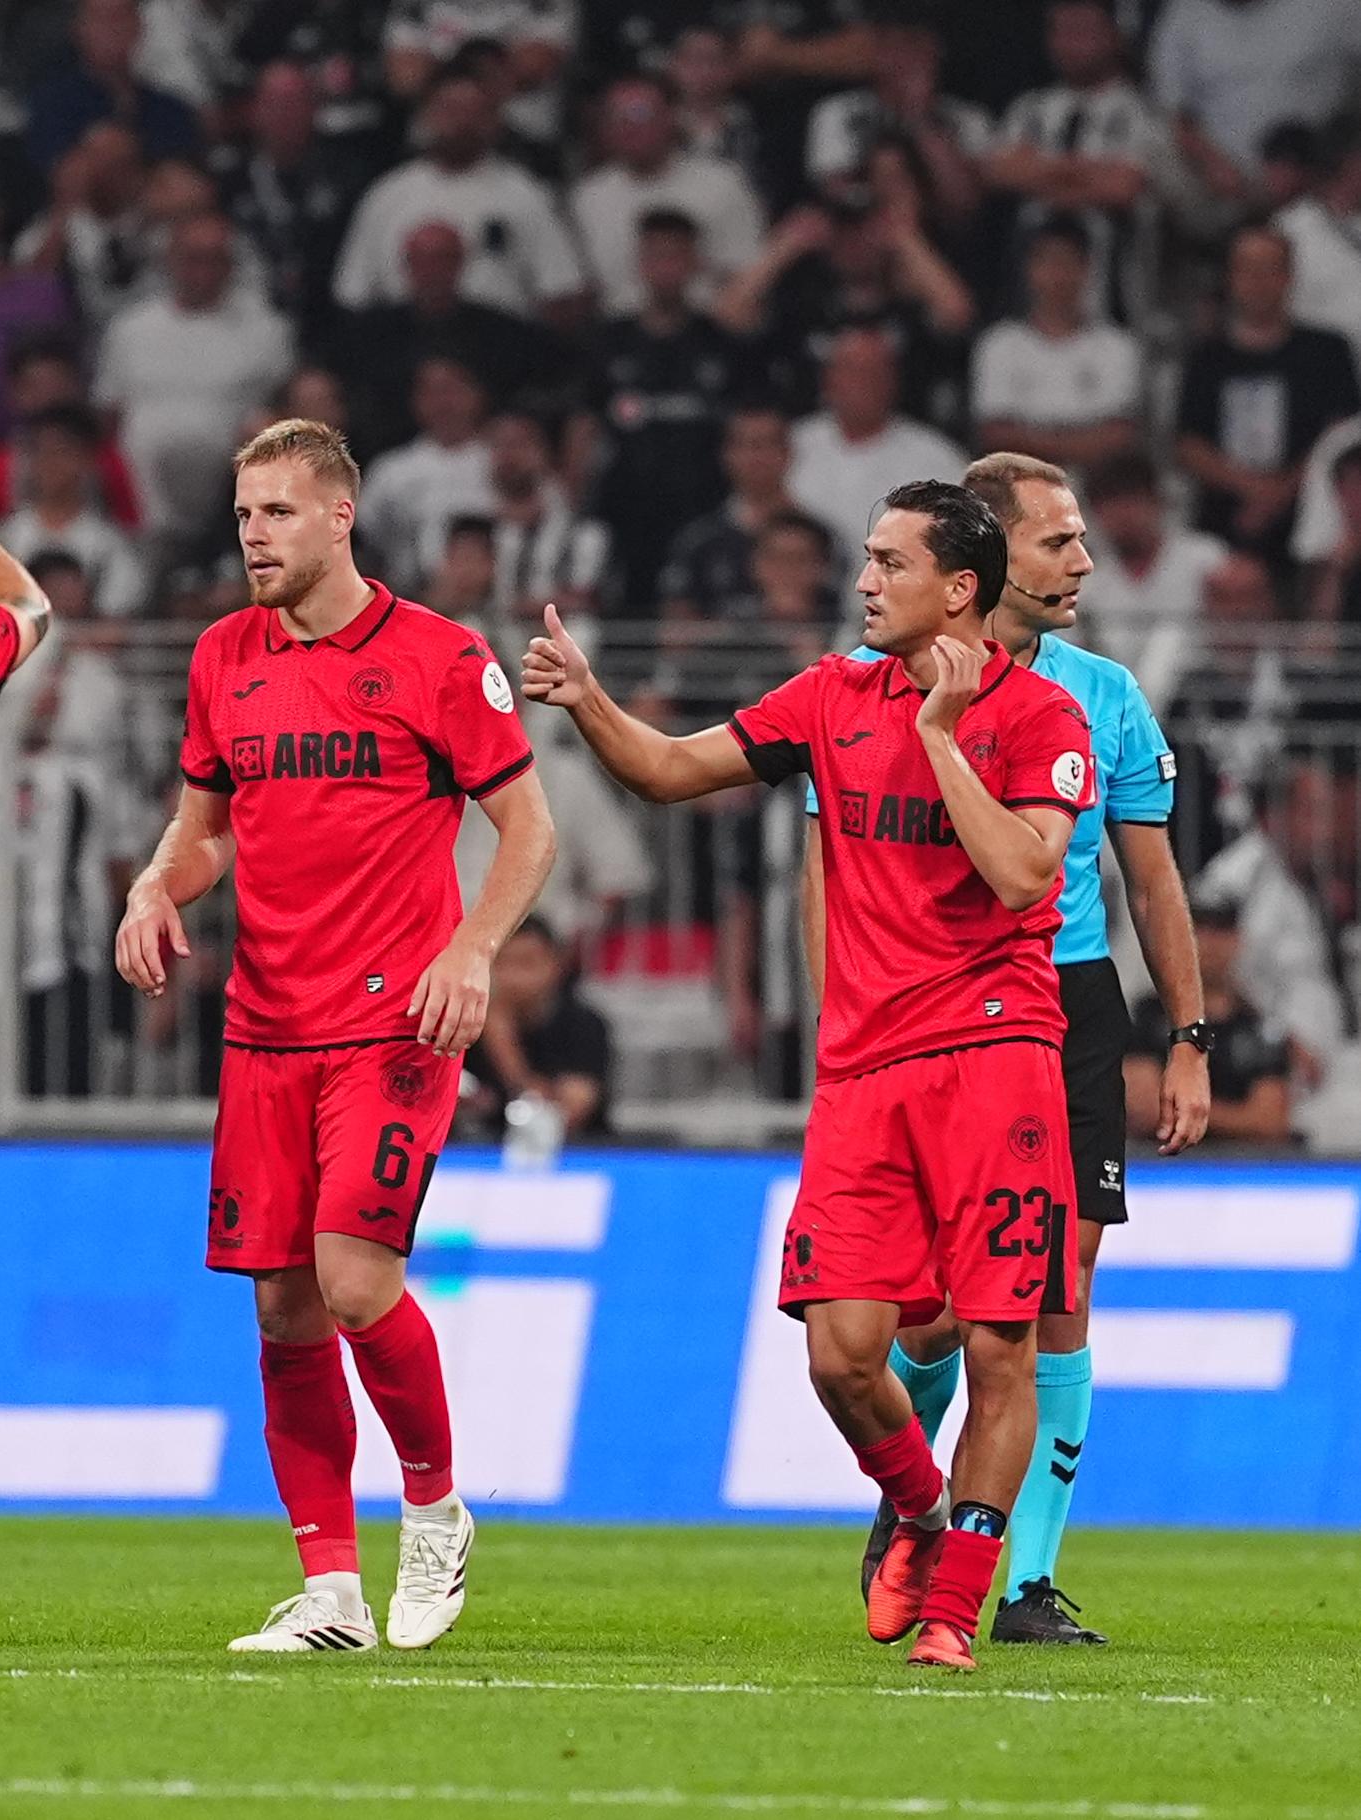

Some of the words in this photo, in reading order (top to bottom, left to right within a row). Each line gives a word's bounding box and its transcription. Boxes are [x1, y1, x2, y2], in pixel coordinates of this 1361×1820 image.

[272, 730, 381, 780] ARCA
[873, 794, 961, 848] ARC
[372, 1121, 415, 1189] 6
[985, 1186, 1052, 1256] 23
